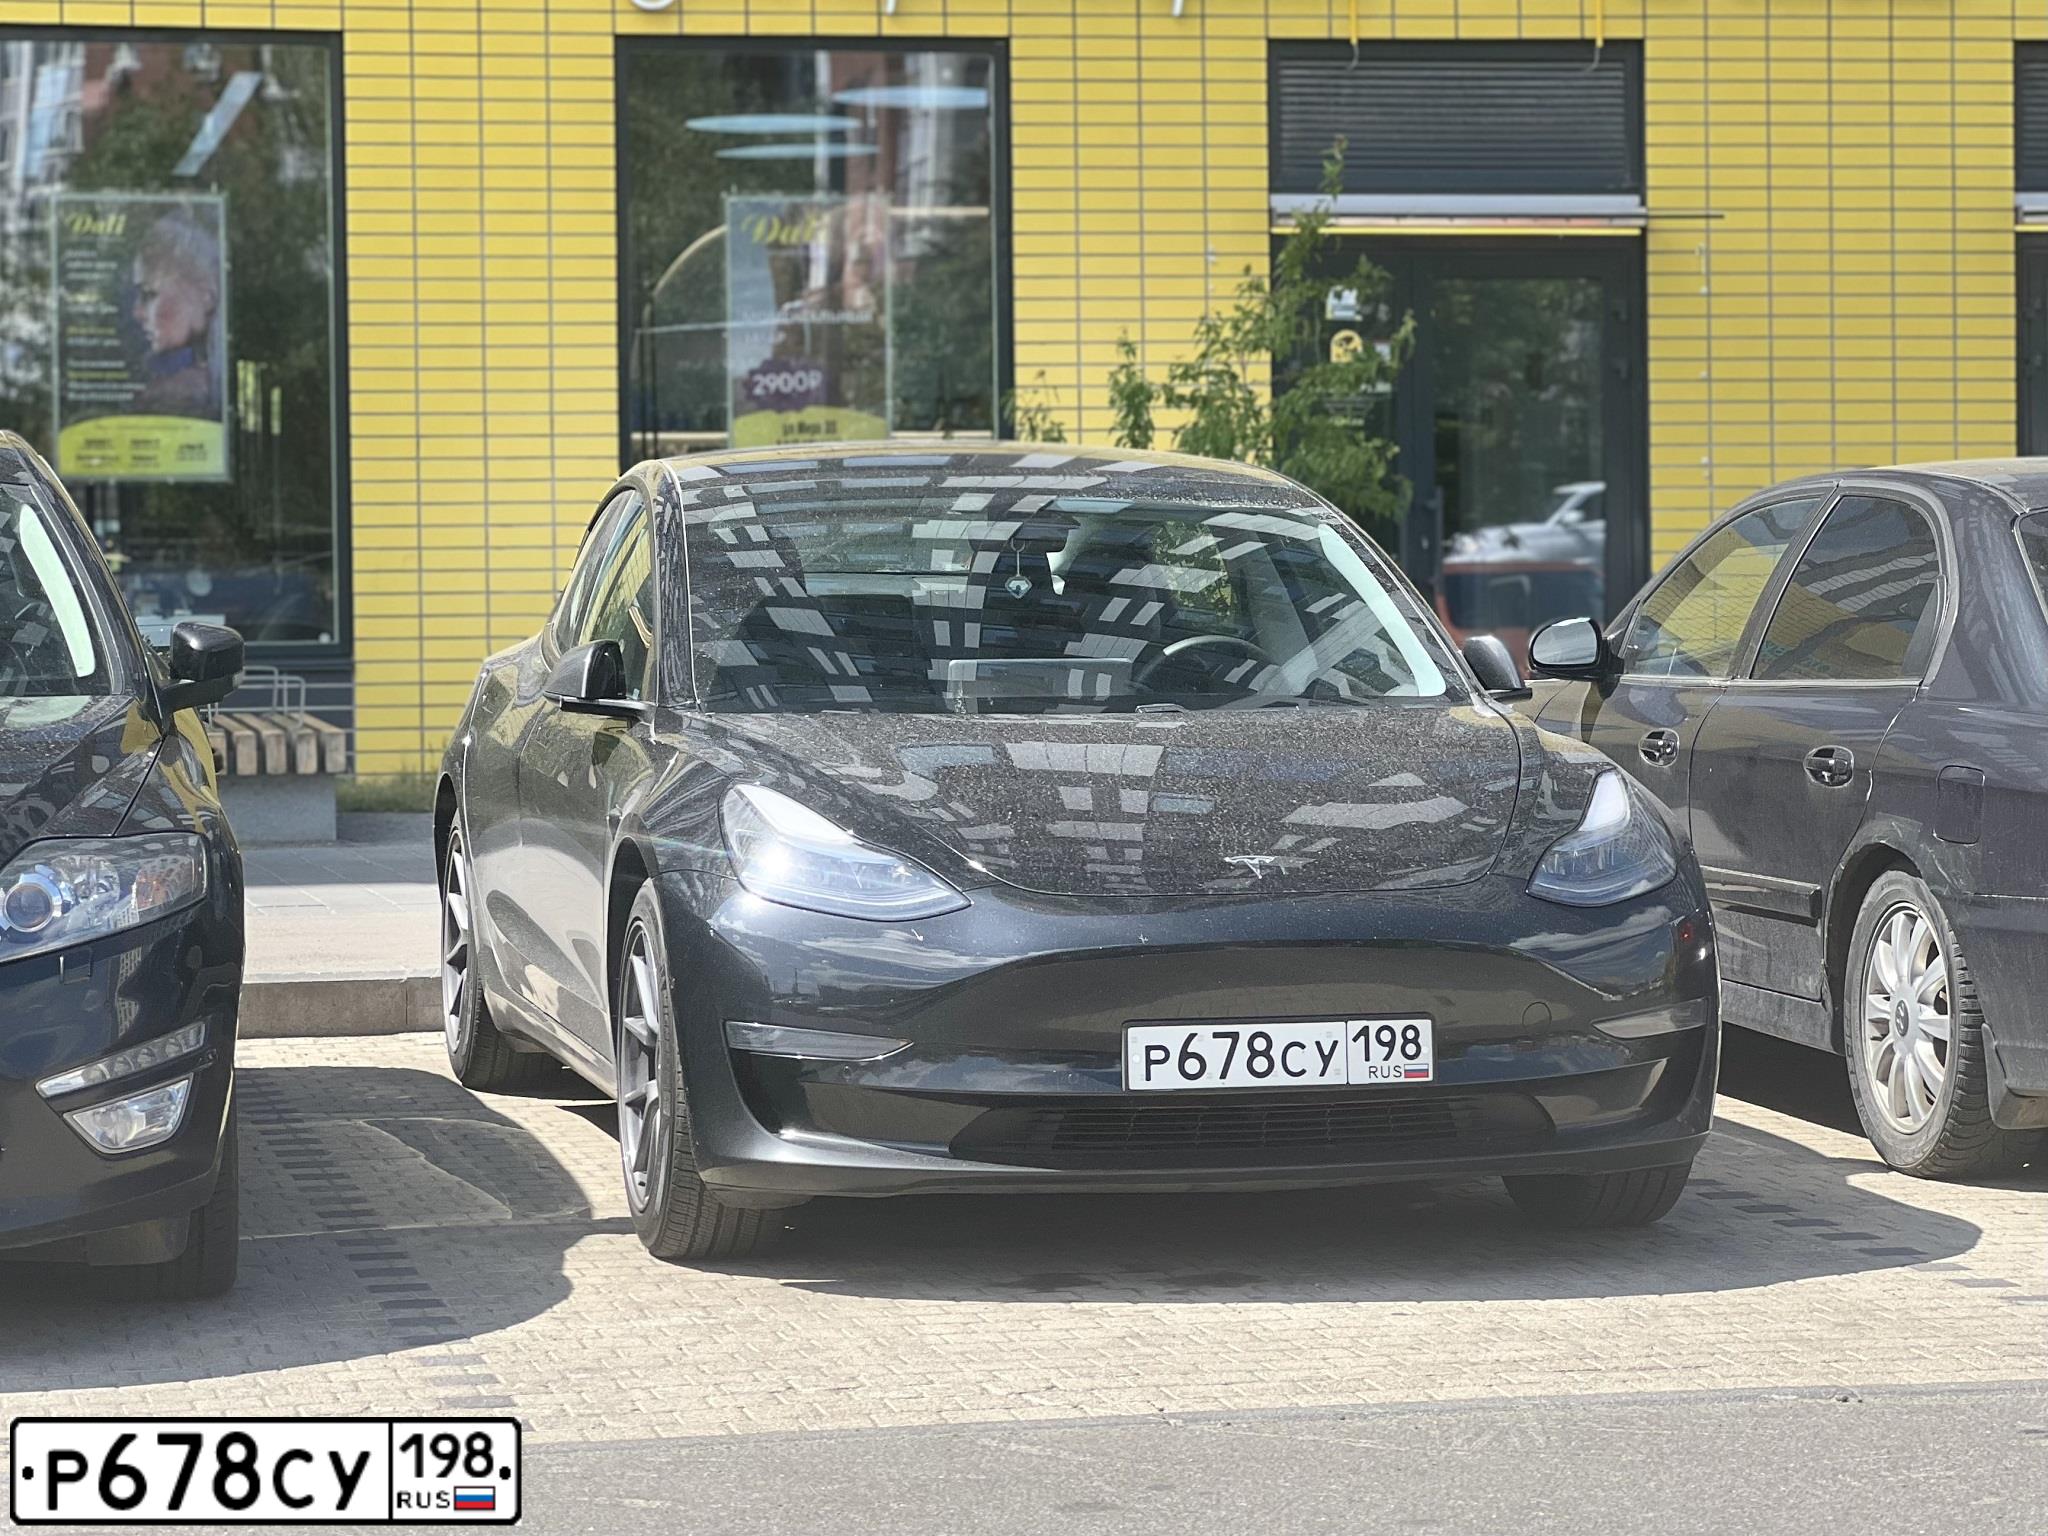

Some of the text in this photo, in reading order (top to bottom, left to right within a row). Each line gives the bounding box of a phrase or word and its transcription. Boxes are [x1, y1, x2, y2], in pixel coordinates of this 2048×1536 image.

[1144, 1024, 1422, 1081] Р678СУ 198
[1368, 1065, 1402, 1079] RUS
